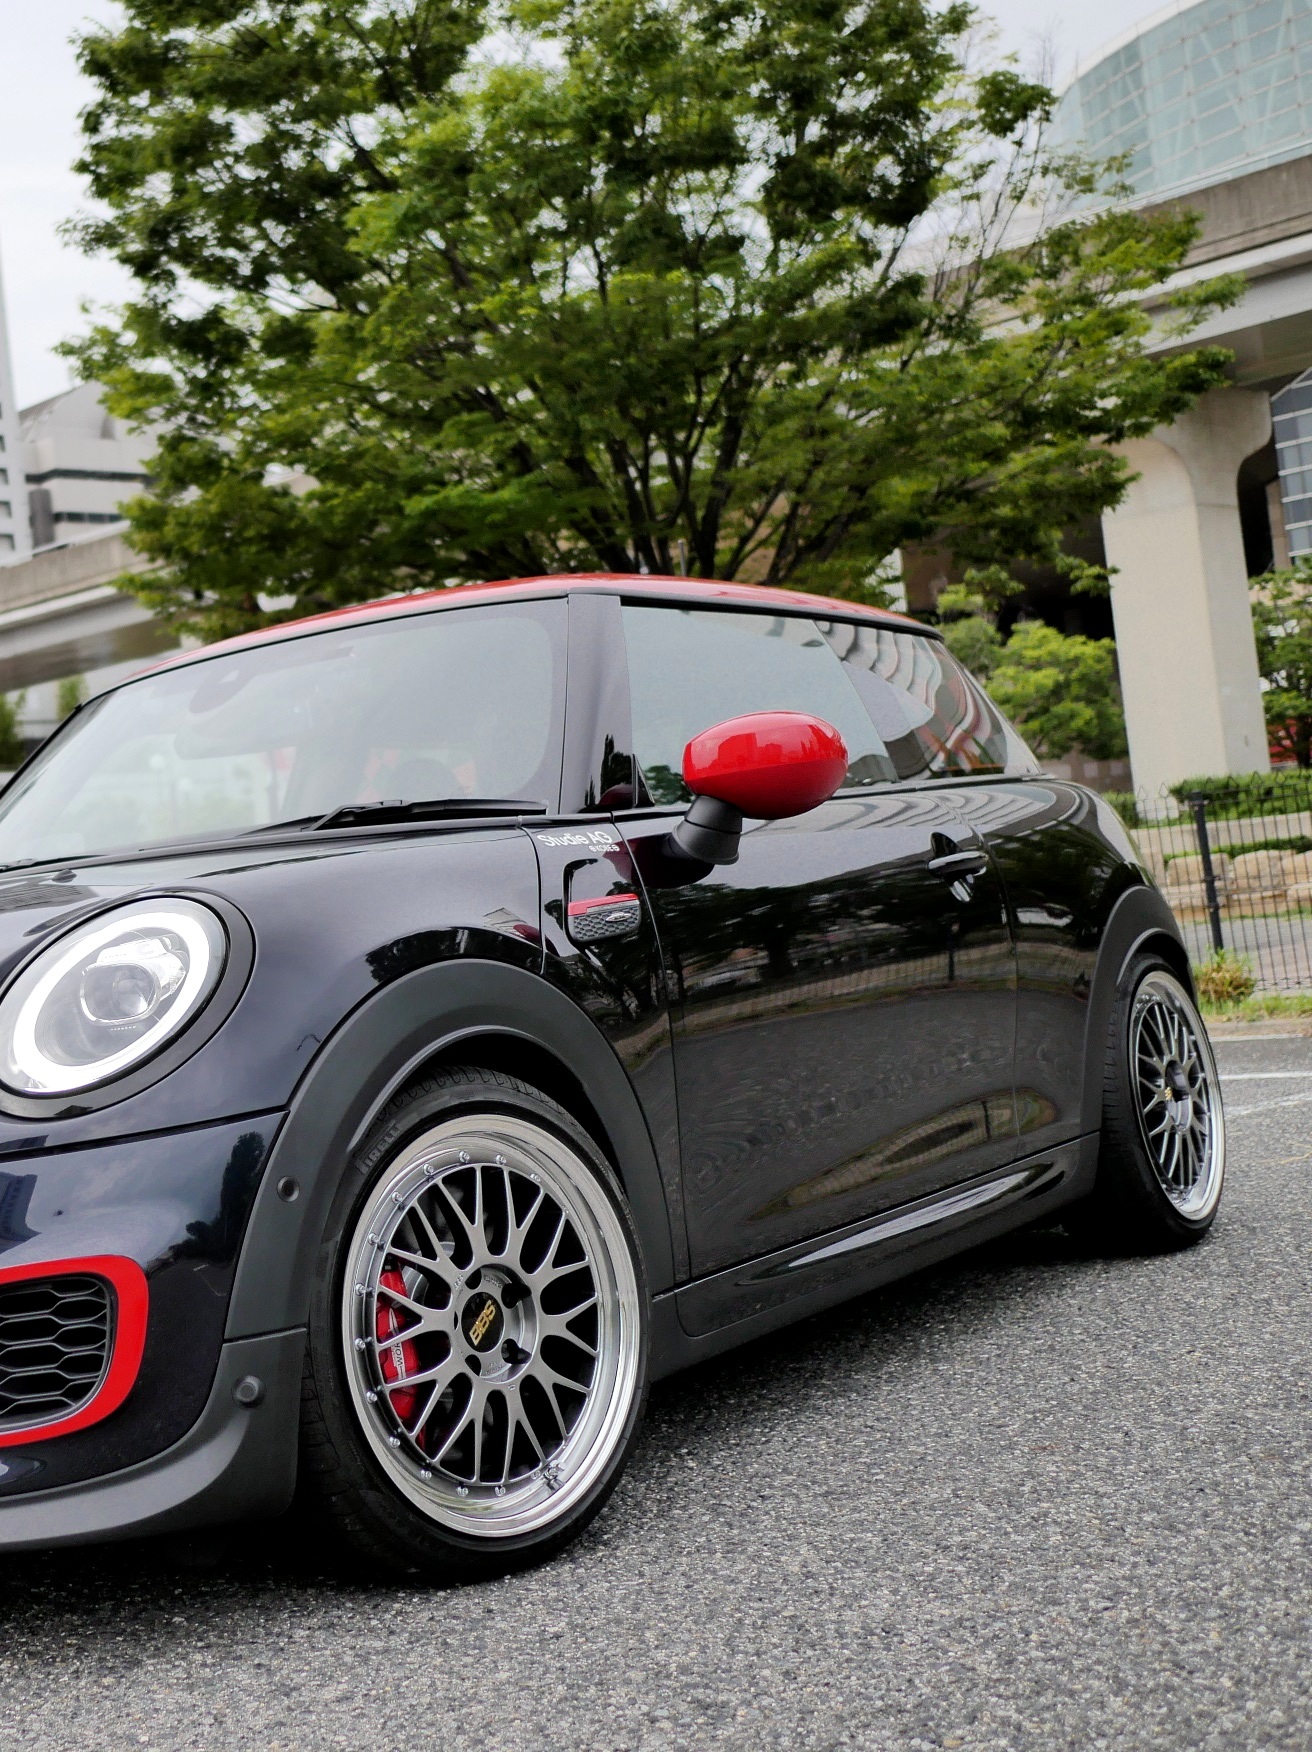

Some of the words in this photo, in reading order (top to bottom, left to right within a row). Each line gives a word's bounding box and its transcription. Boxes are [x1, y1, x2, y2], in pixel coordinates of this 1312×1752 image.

[536, 832, 589, 847] Studie
[586, 831, 612, 844] AG
[469, 1299, 496, 1346] BBS
